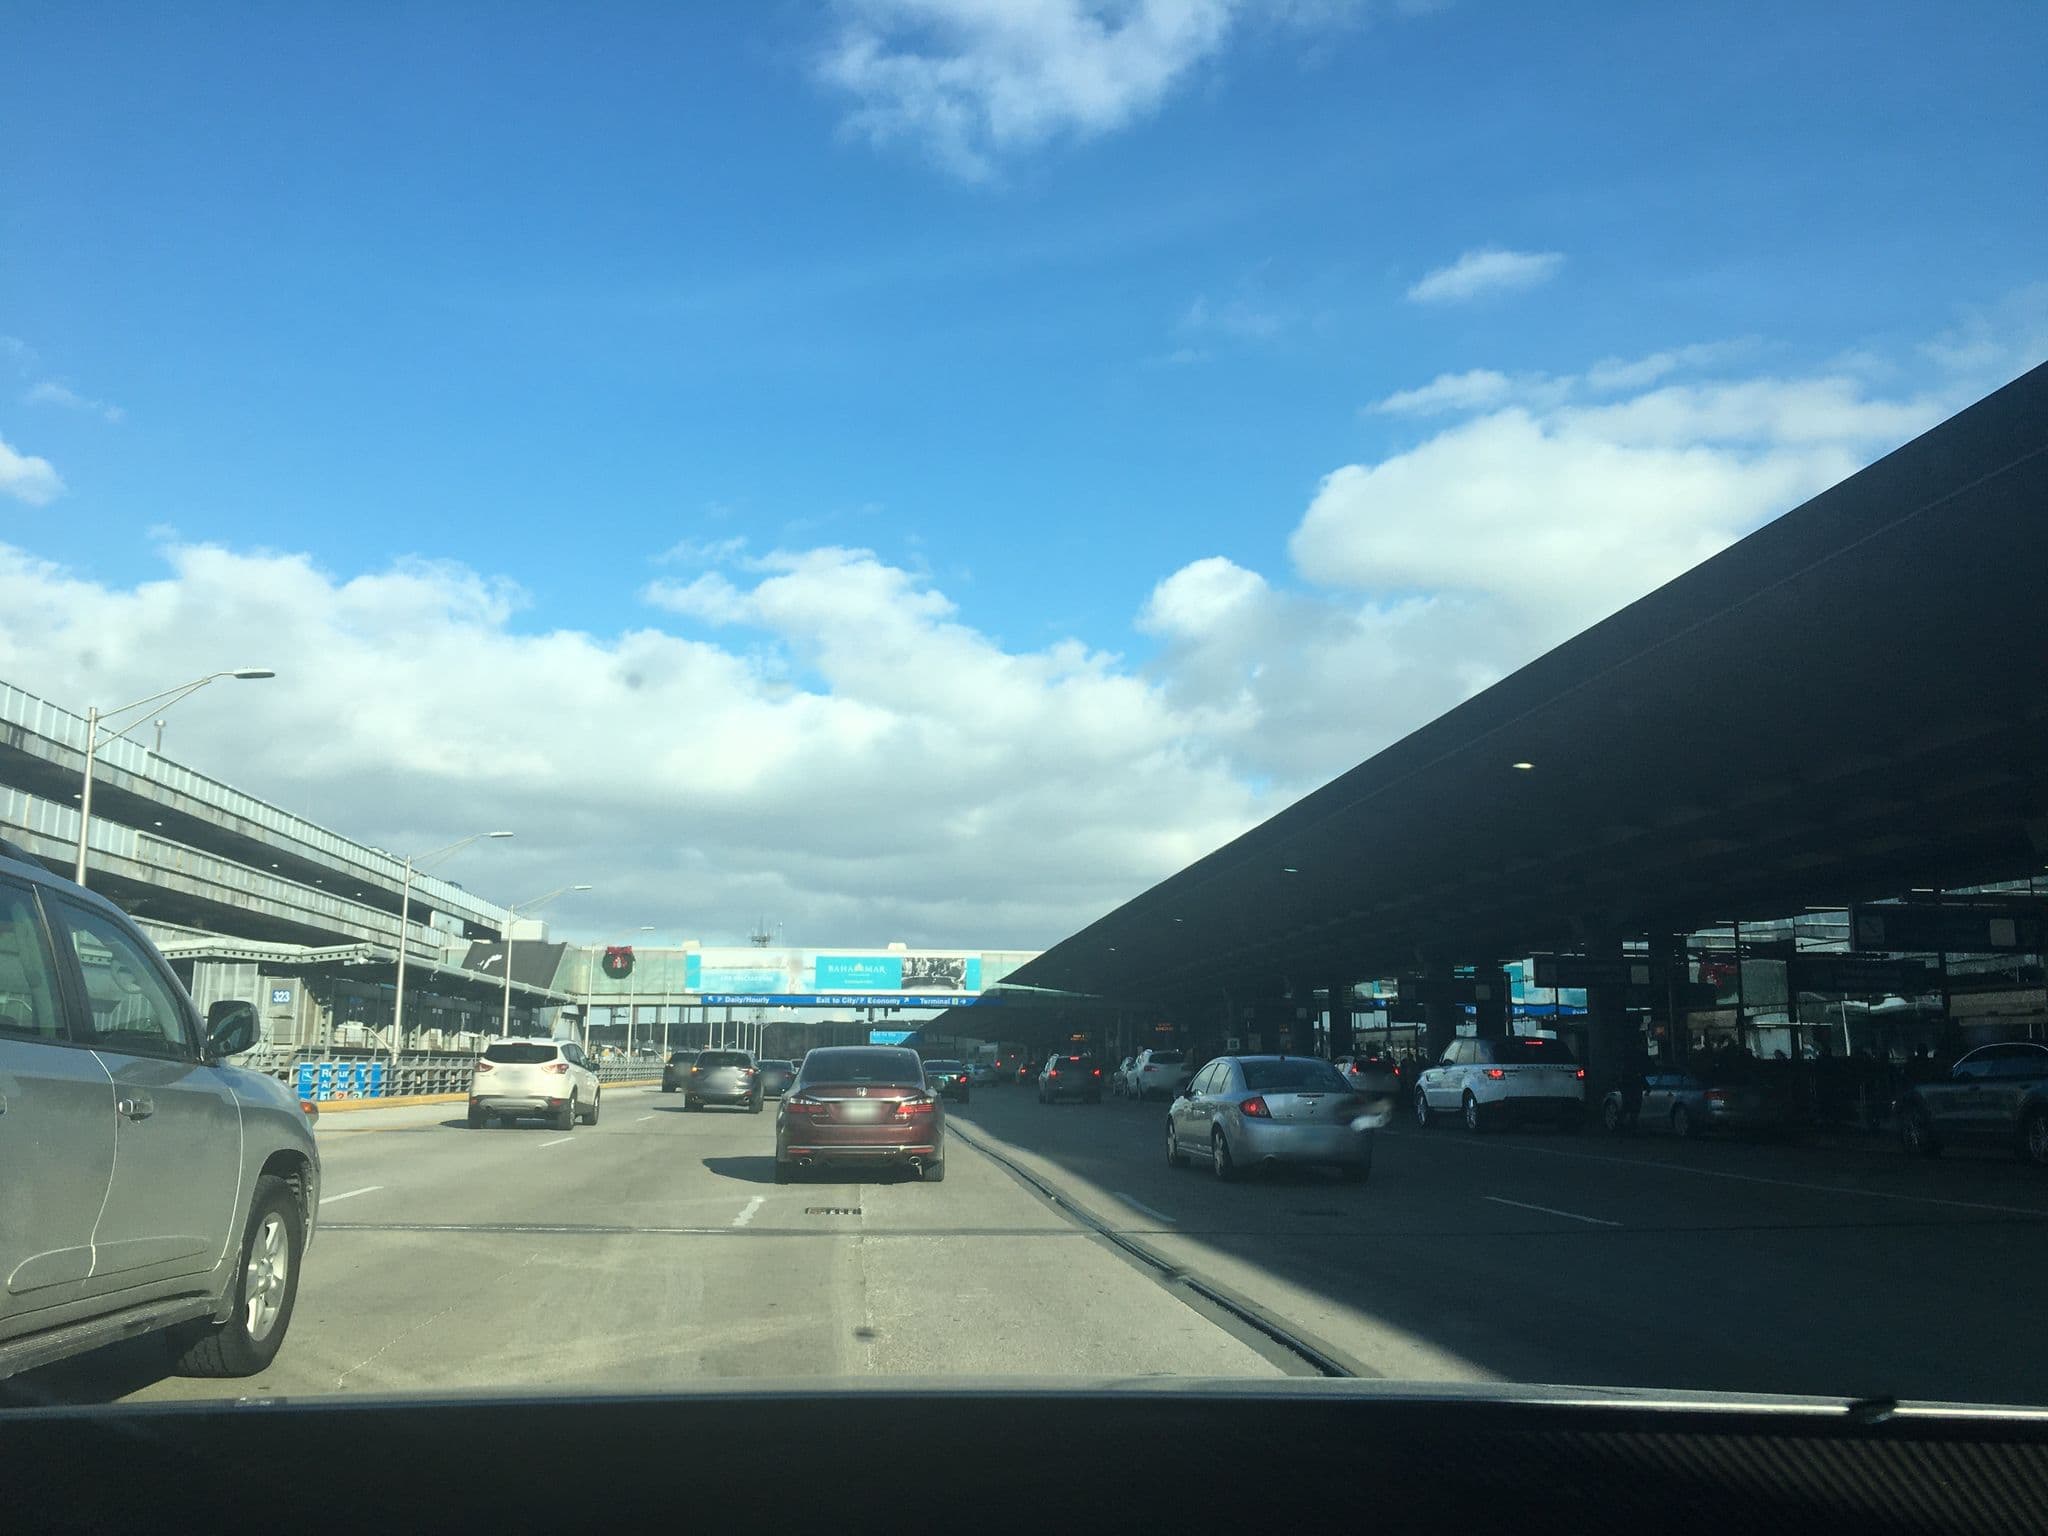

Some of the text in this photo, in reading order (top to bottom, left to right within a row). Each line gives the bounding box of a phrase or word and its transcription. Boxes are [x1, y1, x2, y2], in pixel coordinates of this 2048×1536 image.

[828, 964, 887, 975] BAHA MAR
[274, 991, 290, 1003] 323
[725, 996, 770, 1004] Daily/Hourly
[816, 996, 830, 1004] Exit
[832, 996, 840, 1004] to
[867, 997, 900, 1006] Economy
[920, 997, 951, 1005] Terminal
